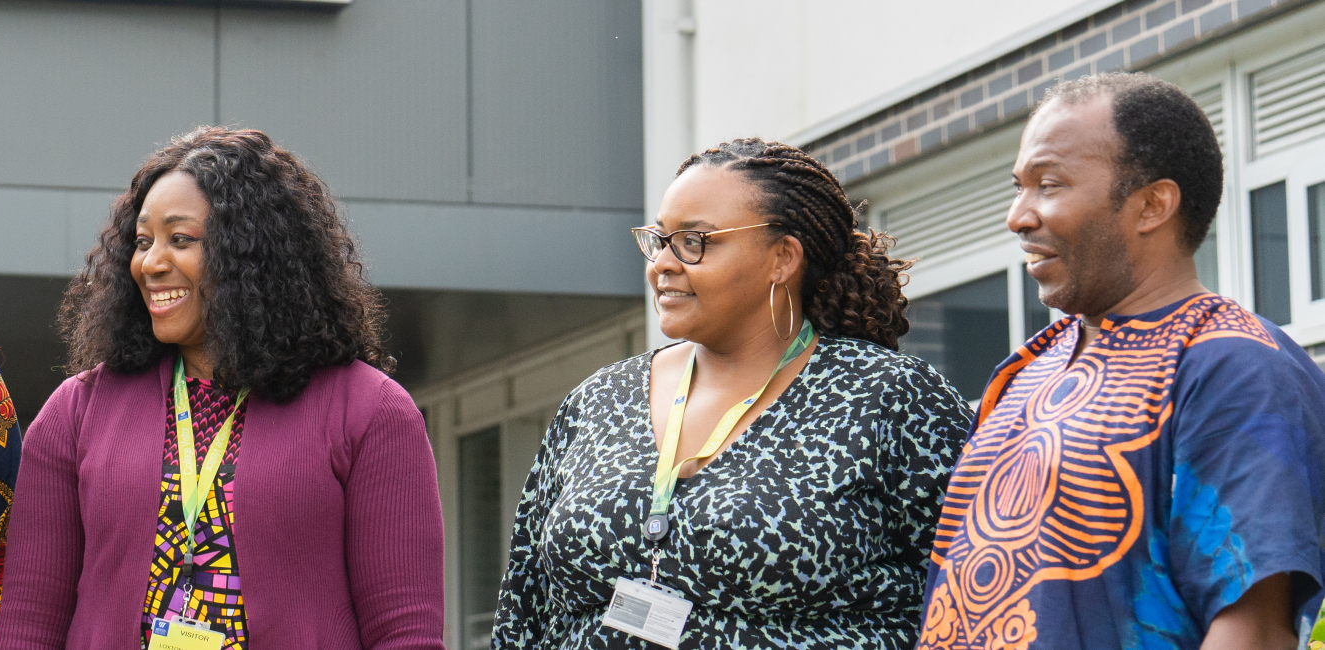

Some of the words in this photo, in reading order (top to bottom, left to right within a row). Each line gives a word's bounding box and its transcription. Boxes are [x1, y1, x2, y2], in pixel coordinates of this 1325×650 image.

[180, 427, 191, 447] Visitor
[216, 422, 232, 448] College
[715, 409, 742, 440] College
[183, 447, 194, 475] College
[205, 448, 222, 472] Visitor
[180, 630, 210, 642] VISITOR
